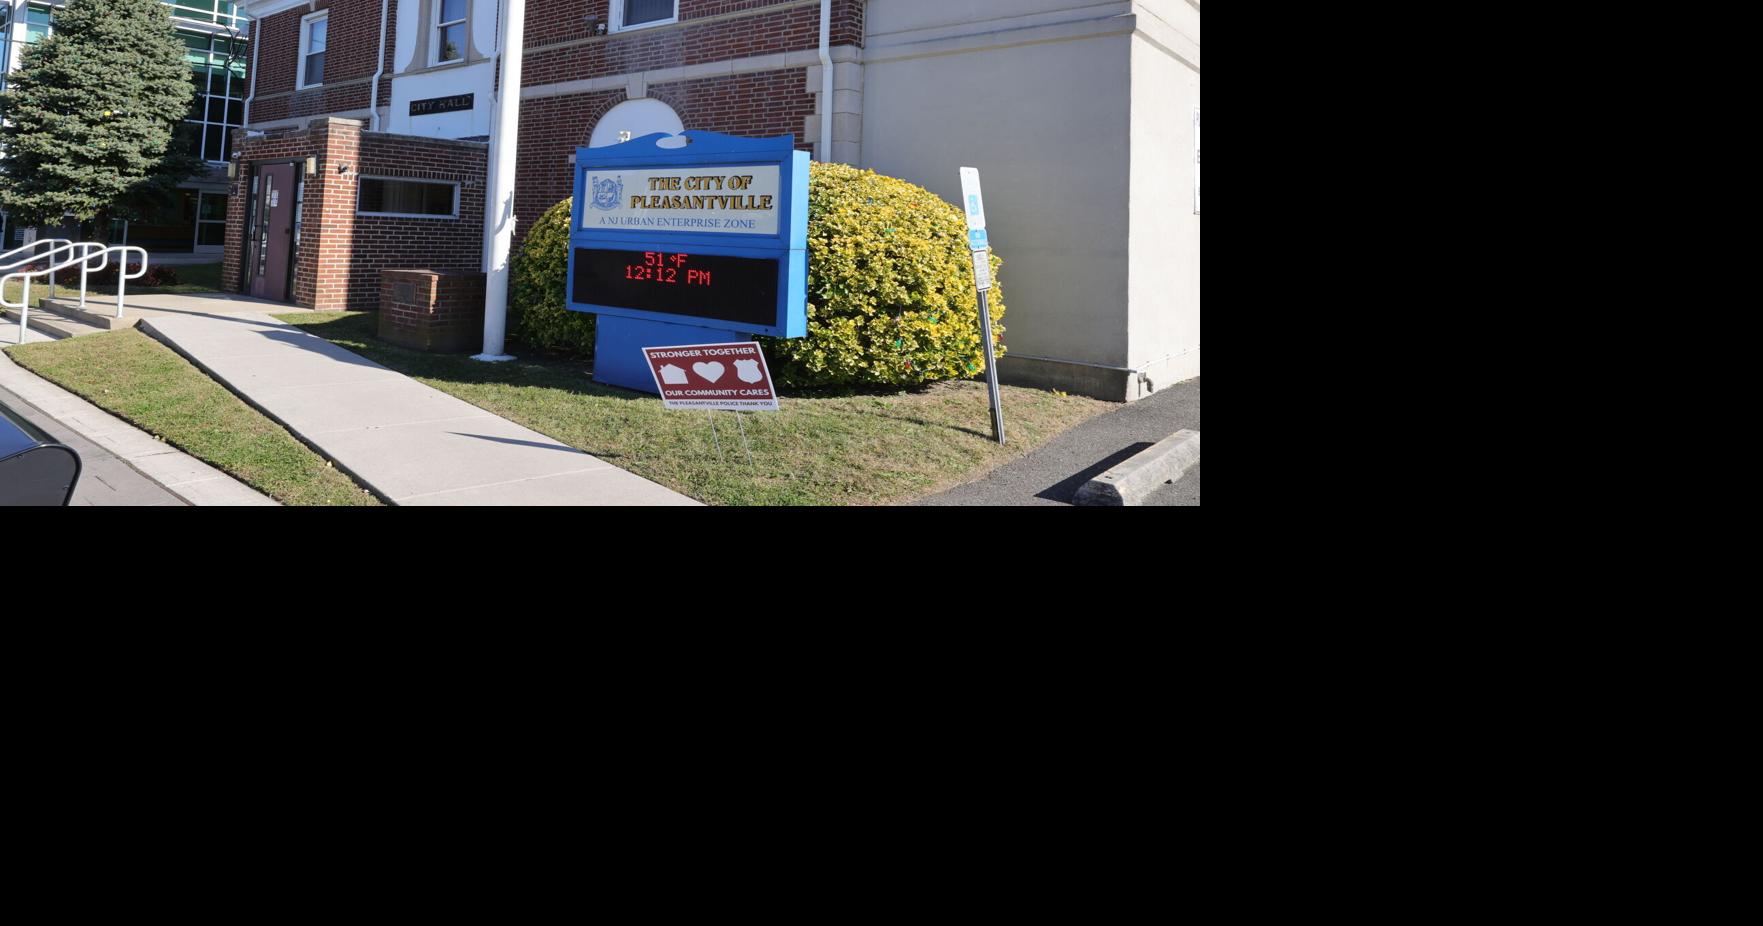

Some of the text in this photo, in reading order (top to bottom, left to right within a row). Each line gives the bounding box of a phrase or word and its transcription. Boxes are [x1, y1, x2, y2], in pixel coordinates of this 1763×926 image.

[648, 175, 754, 191] THE CITY OF
[630, 195, 773, 210] PLEASANTVILLE
[599, 217, 756, 230] A NJ URBAN ENTERPRISE ZONE
[645, 252, 664, 267] 51
[625, 265, 712, 286] 12:12 PM
[650, 347, 756, 359] STRONGER TOGETHER
[685, 389, 738, 397] COMMUNITY
